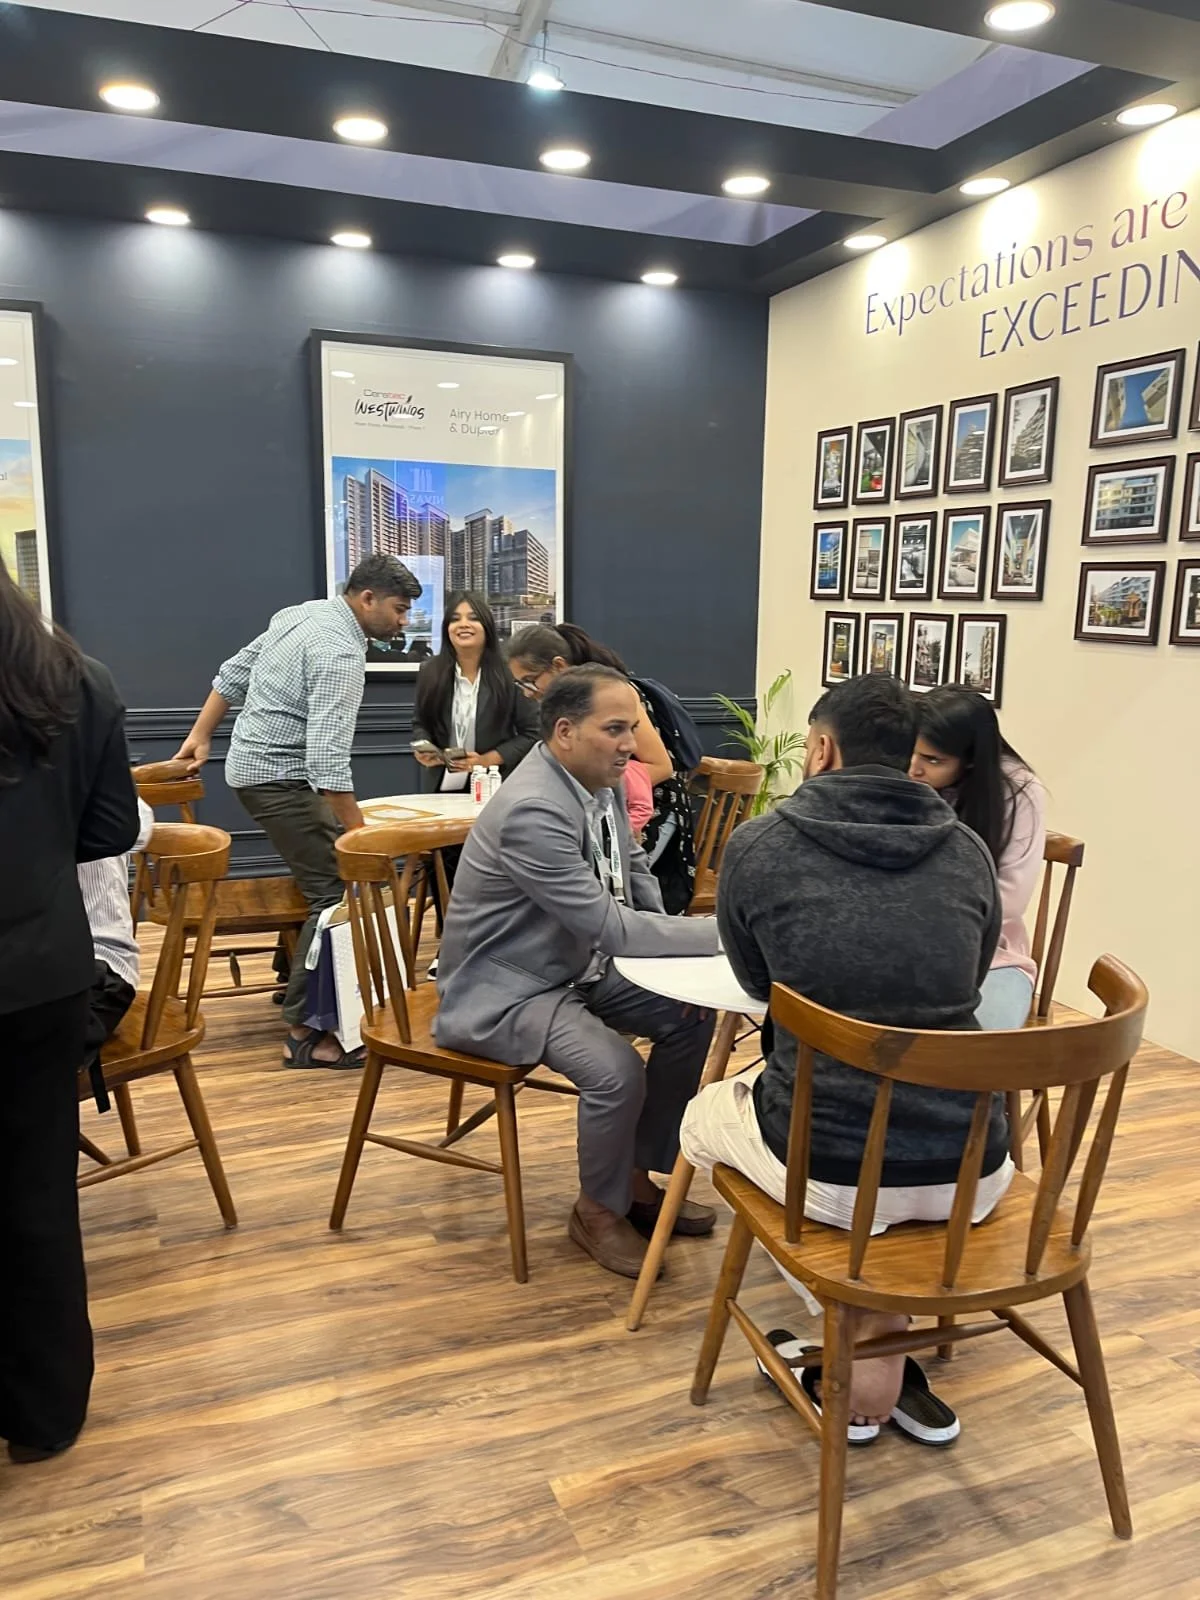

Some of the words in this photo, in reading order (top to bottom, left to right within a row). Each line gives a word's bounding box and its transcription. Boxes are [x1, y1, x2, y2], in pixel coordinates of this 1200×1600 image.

[864, 223, 1095, 336] Expectations
[1110, 190, 1189, 250] are
[449, 408, 471, 422] Airy
[449, 422, 457, 433] &
